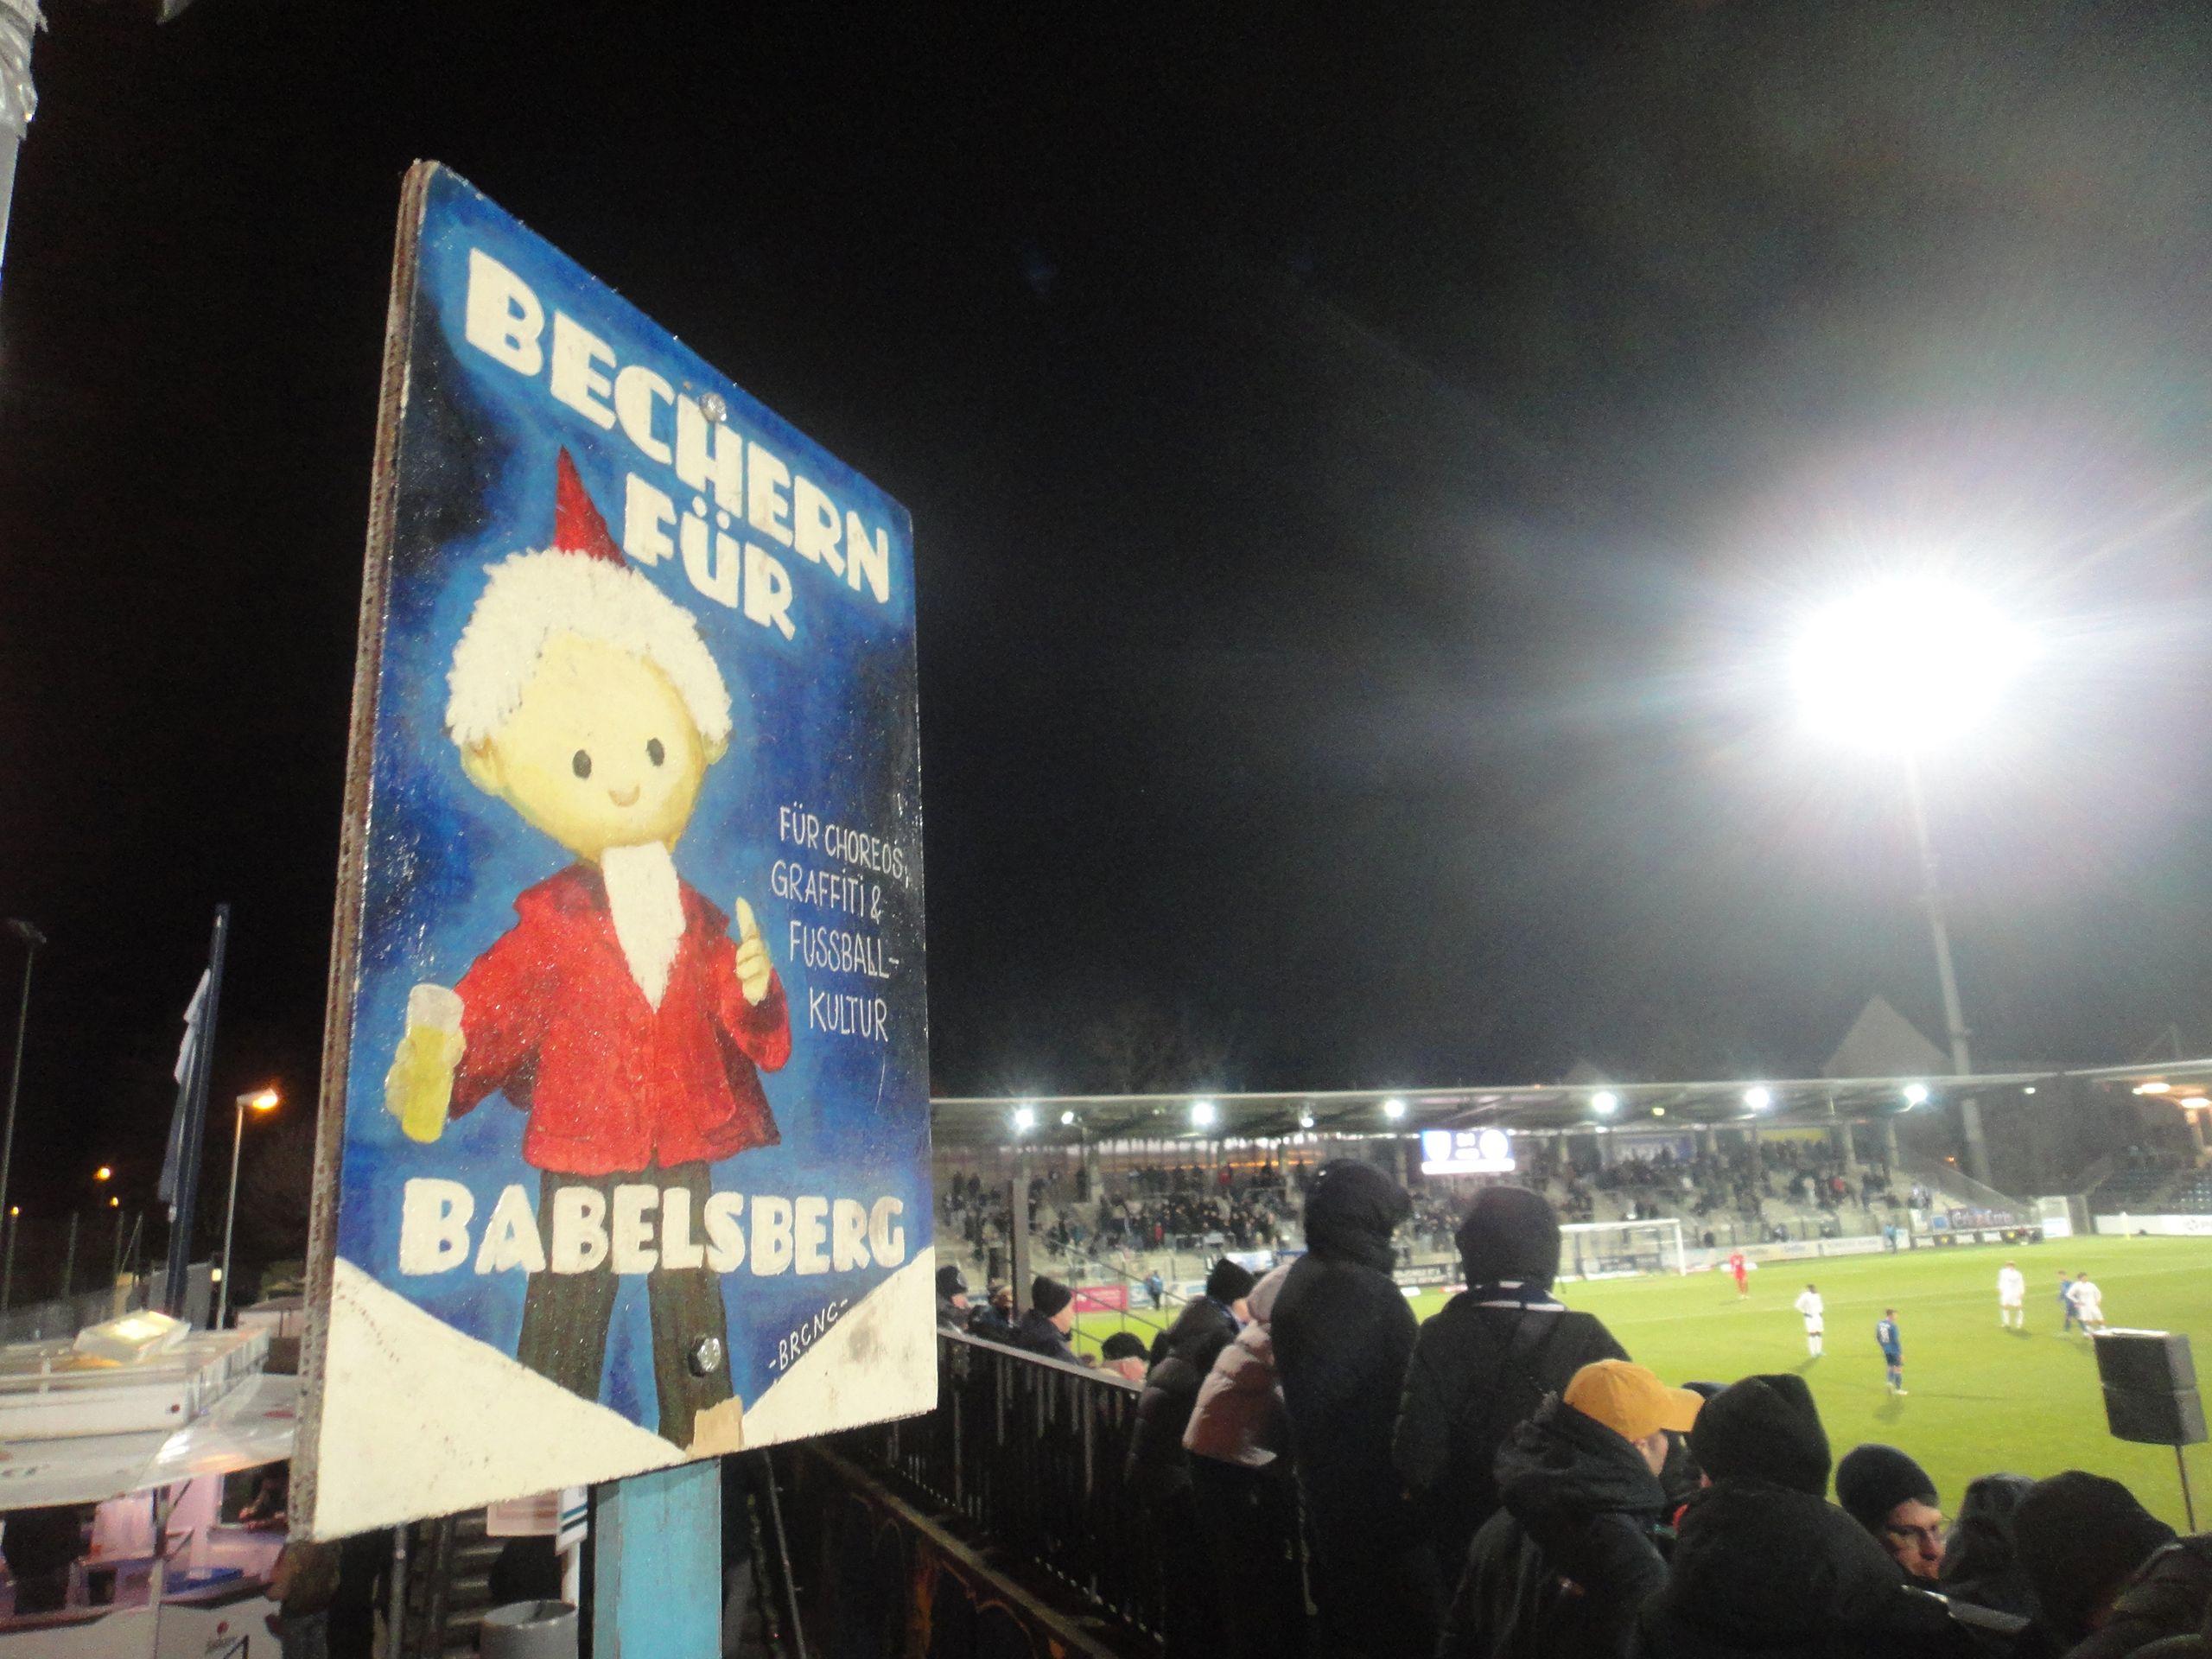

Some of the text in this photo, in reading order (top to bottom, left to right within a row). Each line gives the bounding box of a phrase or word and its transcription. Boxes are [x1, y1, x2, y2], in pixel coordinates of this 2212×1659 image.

[465, 247, 890, 604] BECHERN
[622, 471, 796, 641] FÜR
[779, 801, 819, 850] FÜR
[870, 885, 881, 925] &
[790, 920, 900, 979] FUSSBALL-
[809, 986, 889, 1042] KULTUR
[398, 1177, 906, 1276] BABELSBERG
